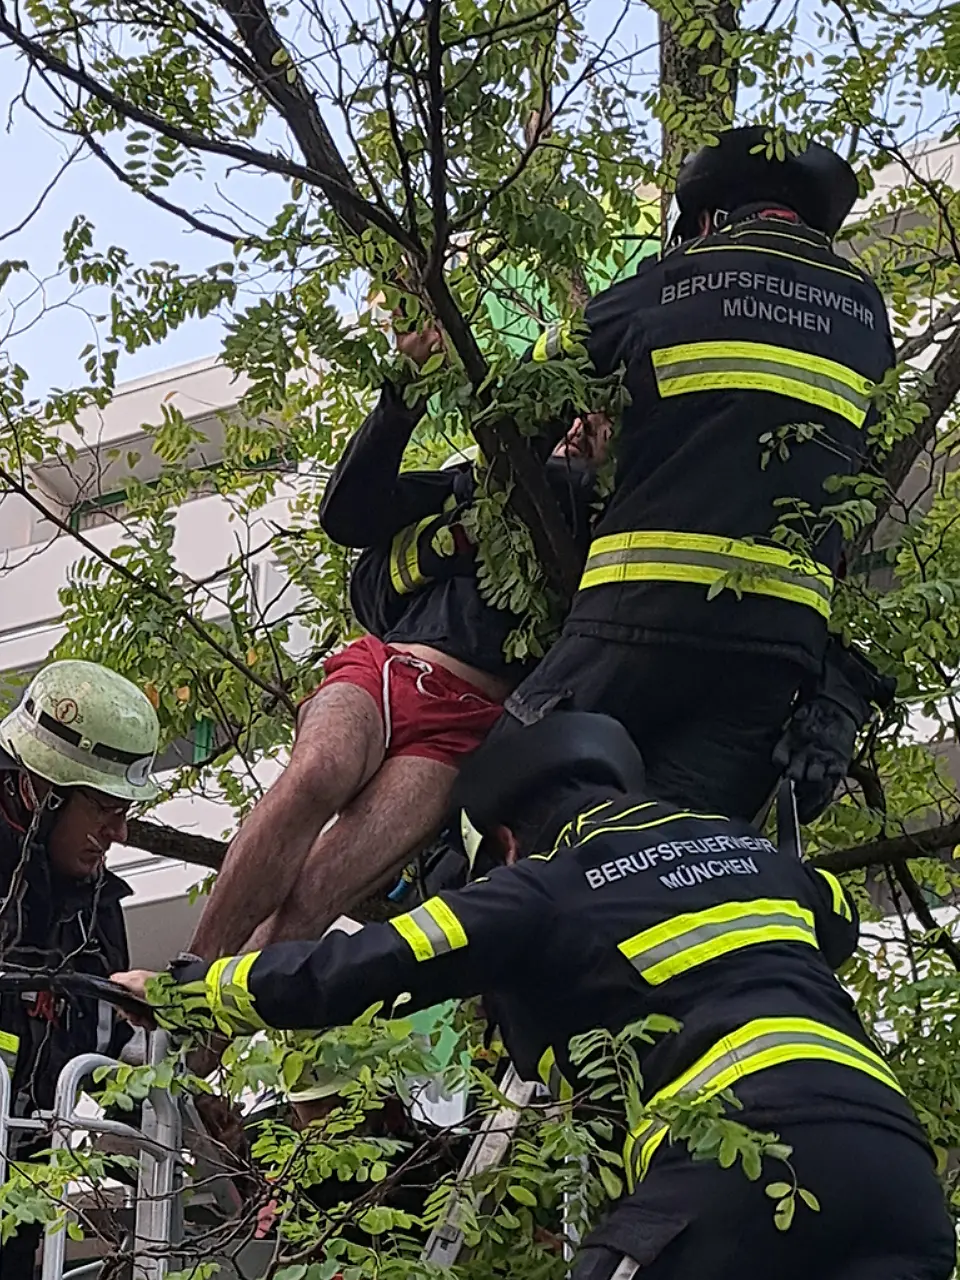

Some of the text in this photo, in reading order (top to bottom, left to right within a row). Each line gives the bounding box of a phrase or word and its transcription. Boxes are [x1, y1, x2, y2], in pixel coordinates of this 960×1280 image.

[661, 271, 875, 330] BERUFSFEUERWEHR
[723, 296, 831, 334] MÜNCHEN
[659, 857, 759, 890] MÜNCHEN
